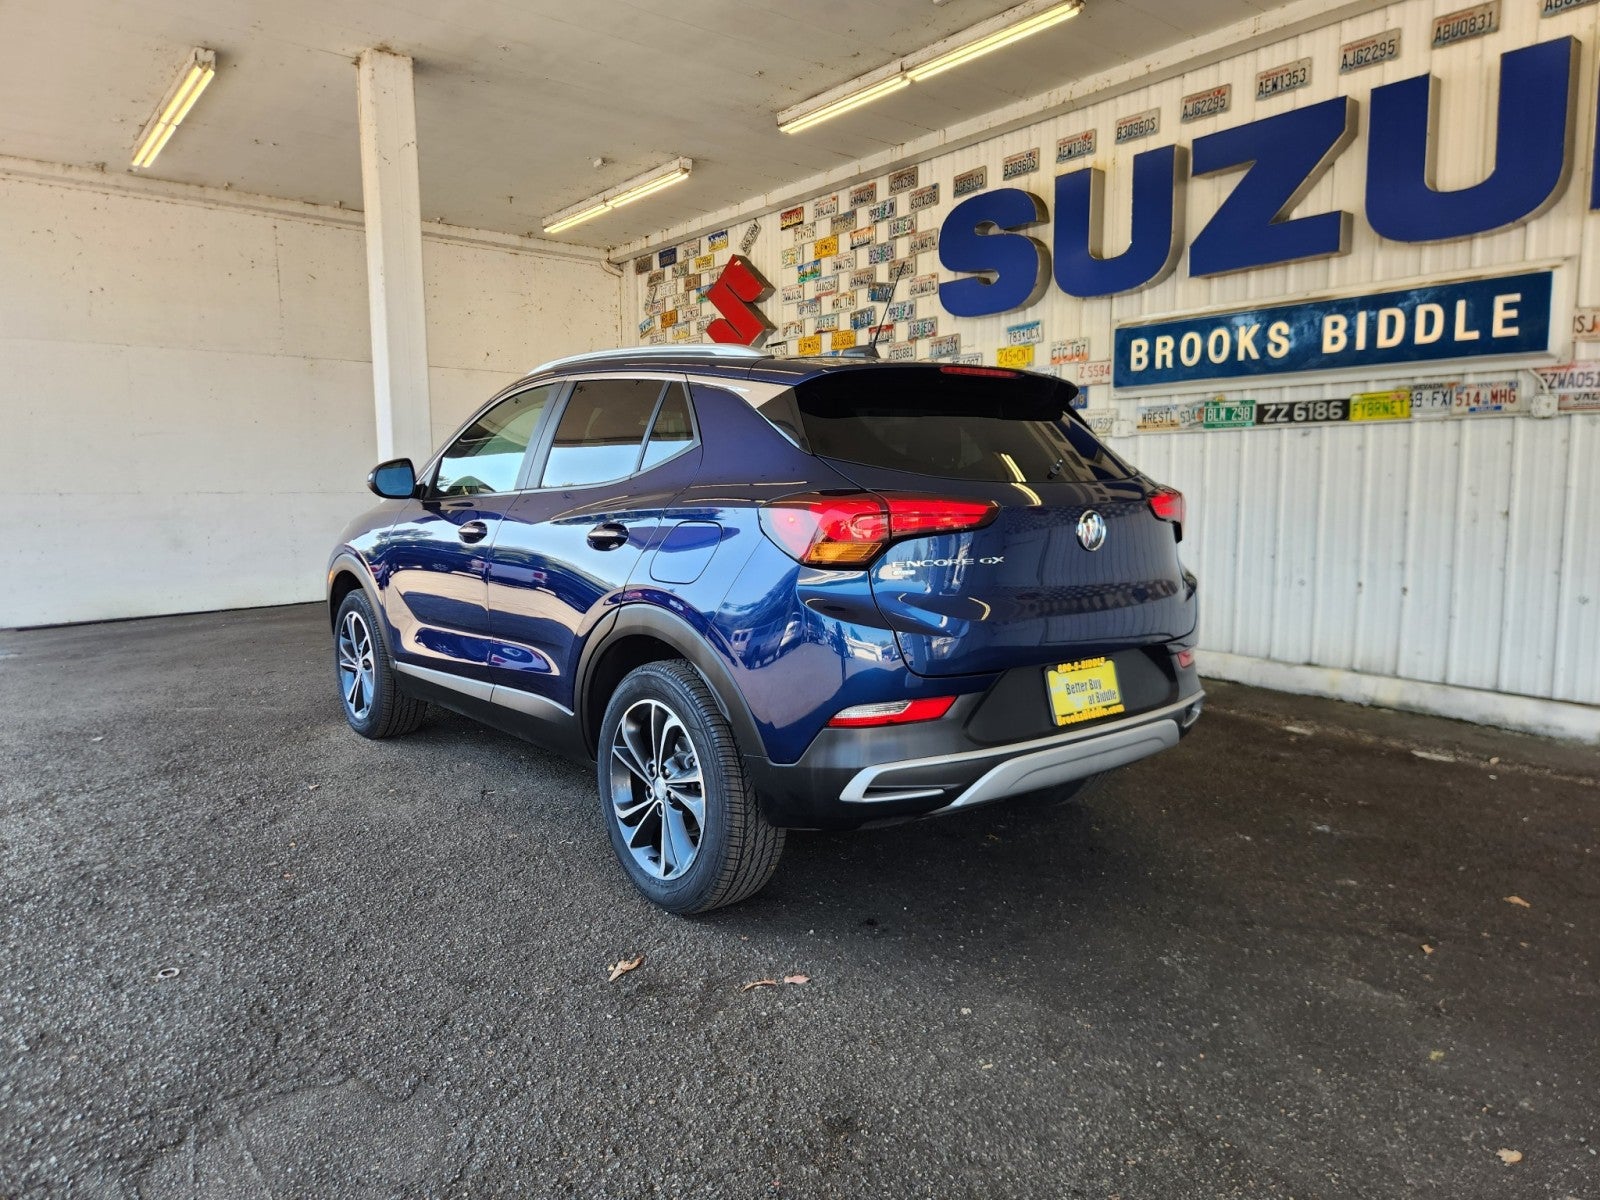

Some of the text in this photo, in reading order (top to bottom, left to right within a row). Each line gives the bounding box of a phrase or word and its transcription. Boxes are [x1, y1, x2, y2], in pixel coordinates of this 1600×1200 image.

[1341, 39, 1396, 70] AJG2295
[1258, 67, 1307, 96] AEW1353
[939, 35, 1600, 317] SUZU
[1130, 292, 1522, 372] BROOKS BIDDLE
[1263, 401, 1344, 423] ZZ 6186
[891, 556, 1005, 568] ENCORE GX
[1065, 678, 1102, 695] Better Buy
